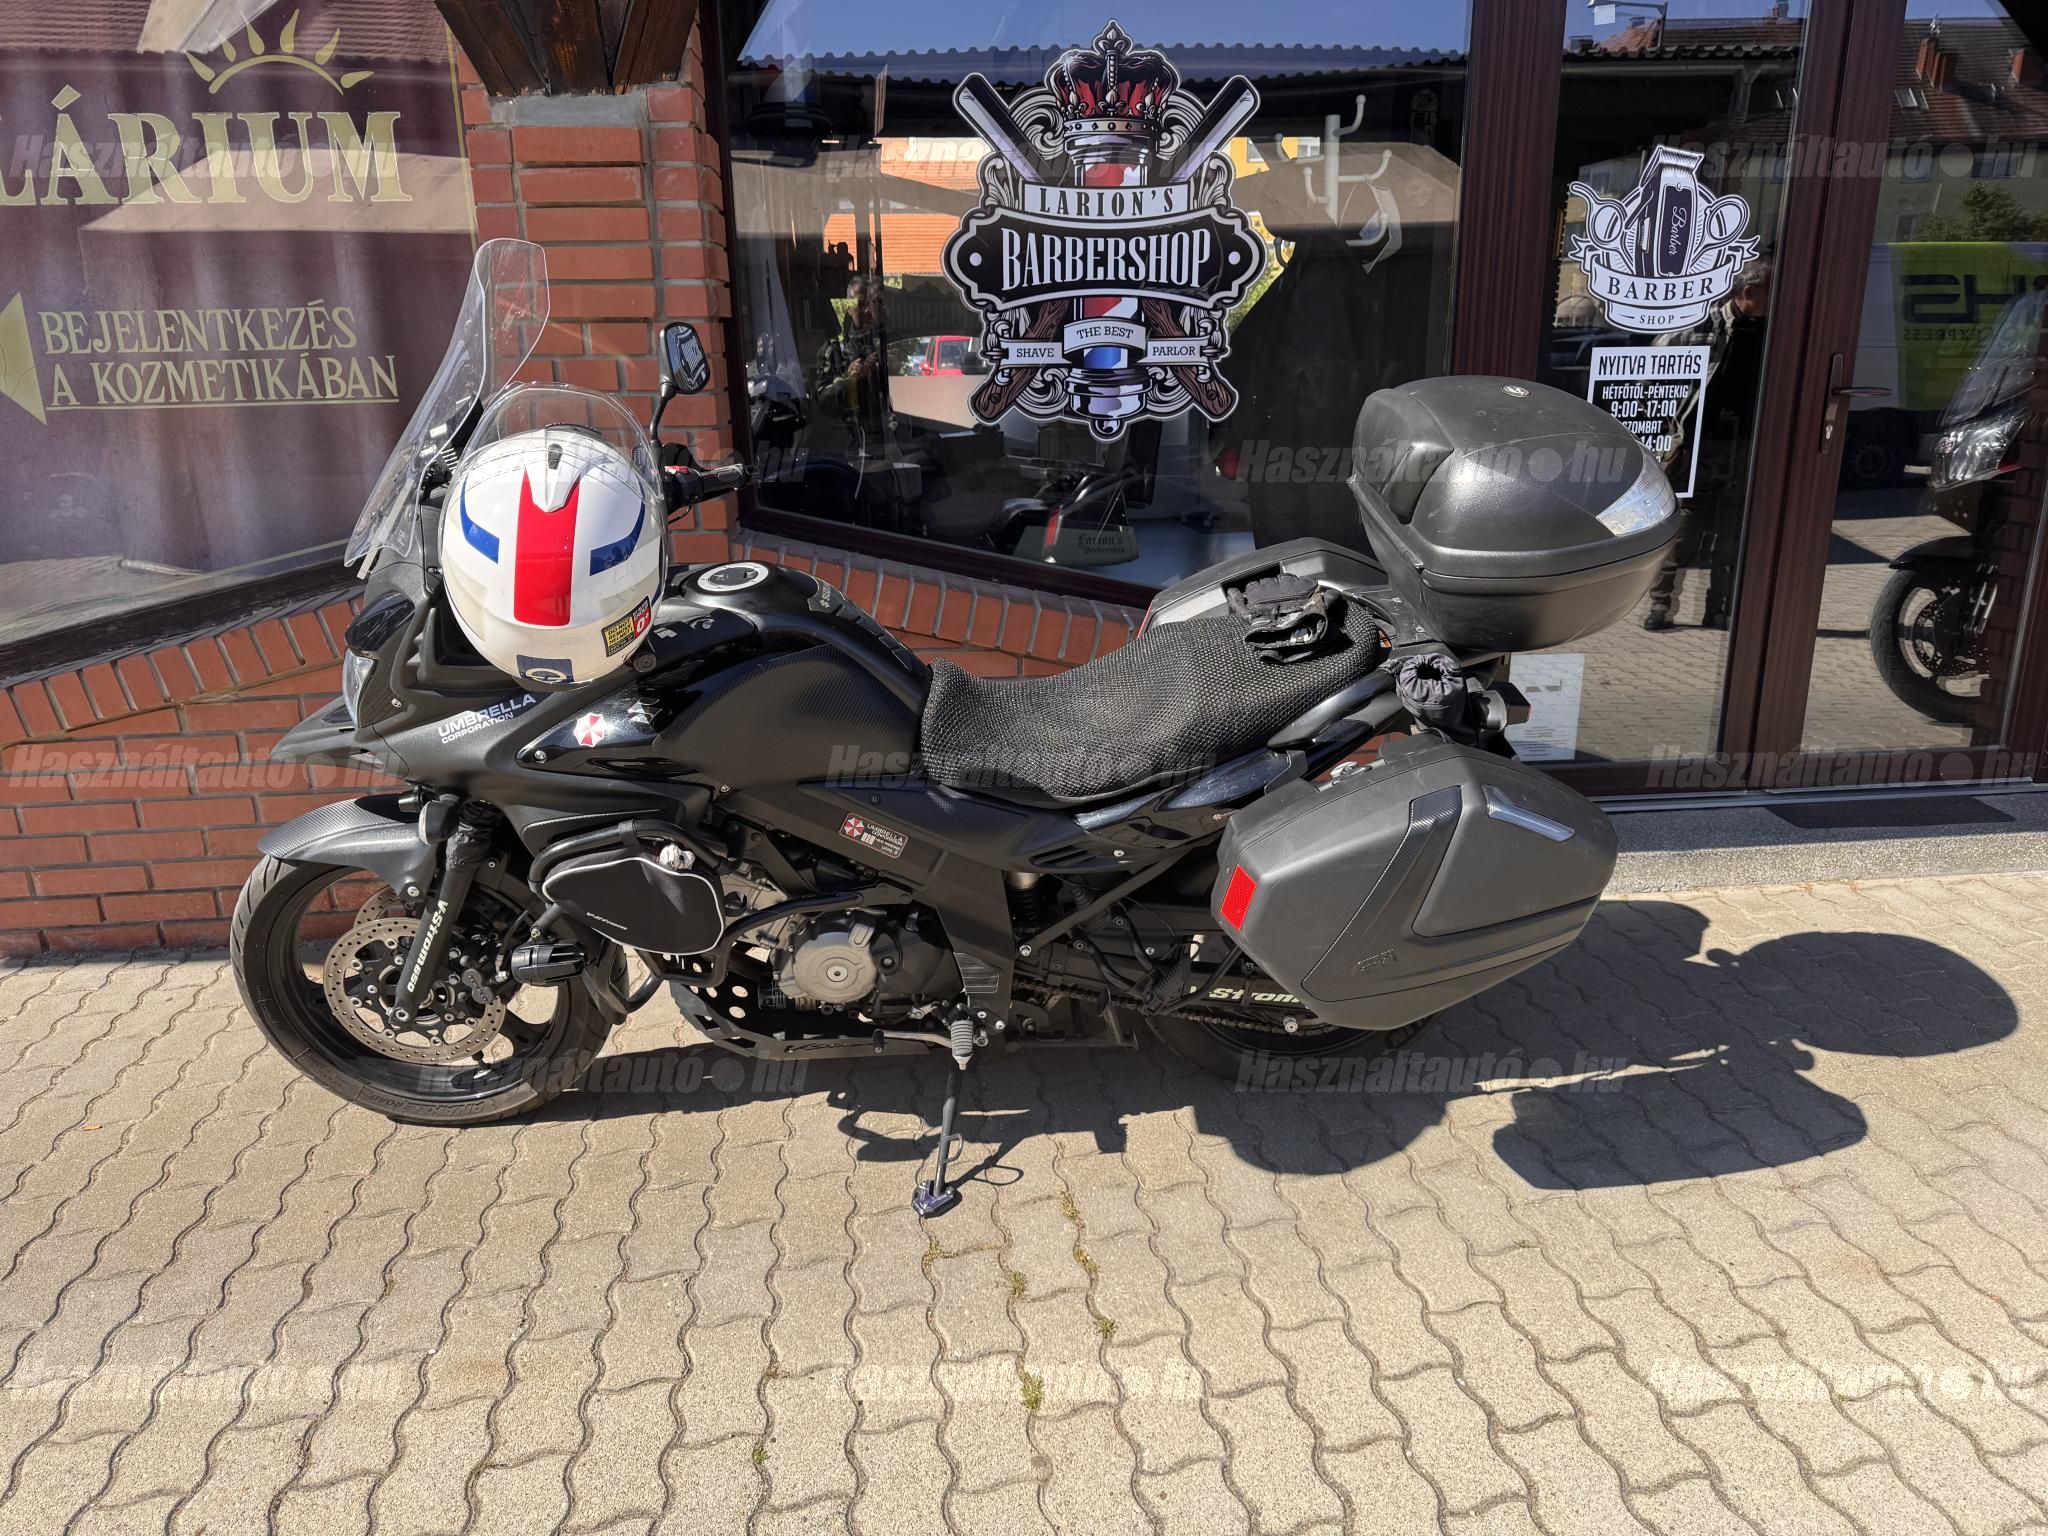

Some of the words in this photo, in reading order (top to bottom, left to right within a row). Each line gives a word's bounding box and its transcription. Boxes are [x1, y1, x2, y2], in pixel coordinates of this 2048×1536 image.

[1039, 187, 1173, 217] LARION'S
[1668, 206, 1687, 257] Barber
[1001, 227, 1211, 291] BARBERSHOP
[1607, 275, 1713, 300] BARBER
[38, 299, 357, 354] BEJELENTKEZÉS
[1076, 325, 1101, 340] THE
[1104, 325, 1134, 339] BEST
[1639, 314, 1675, 324] SHOP
[1016, 347, 1055, 358] SHAVE
[1152, 346, 1196, 357] PARLOR
[1598, 355, 1646, 375] NYITVA
[1651, 350, 1702, 374] TARTÁS
[51, 364, 81, 406] A
[90, 351, 399, 404] KOZMETIKÁBAN
[1602, 383, 1689, 400] HÉTFŐTŐL-PÉNTEKIG
[438, 694, 536, 737] UMBRELLA
[441, 712, 514, 744] CORPORATION
